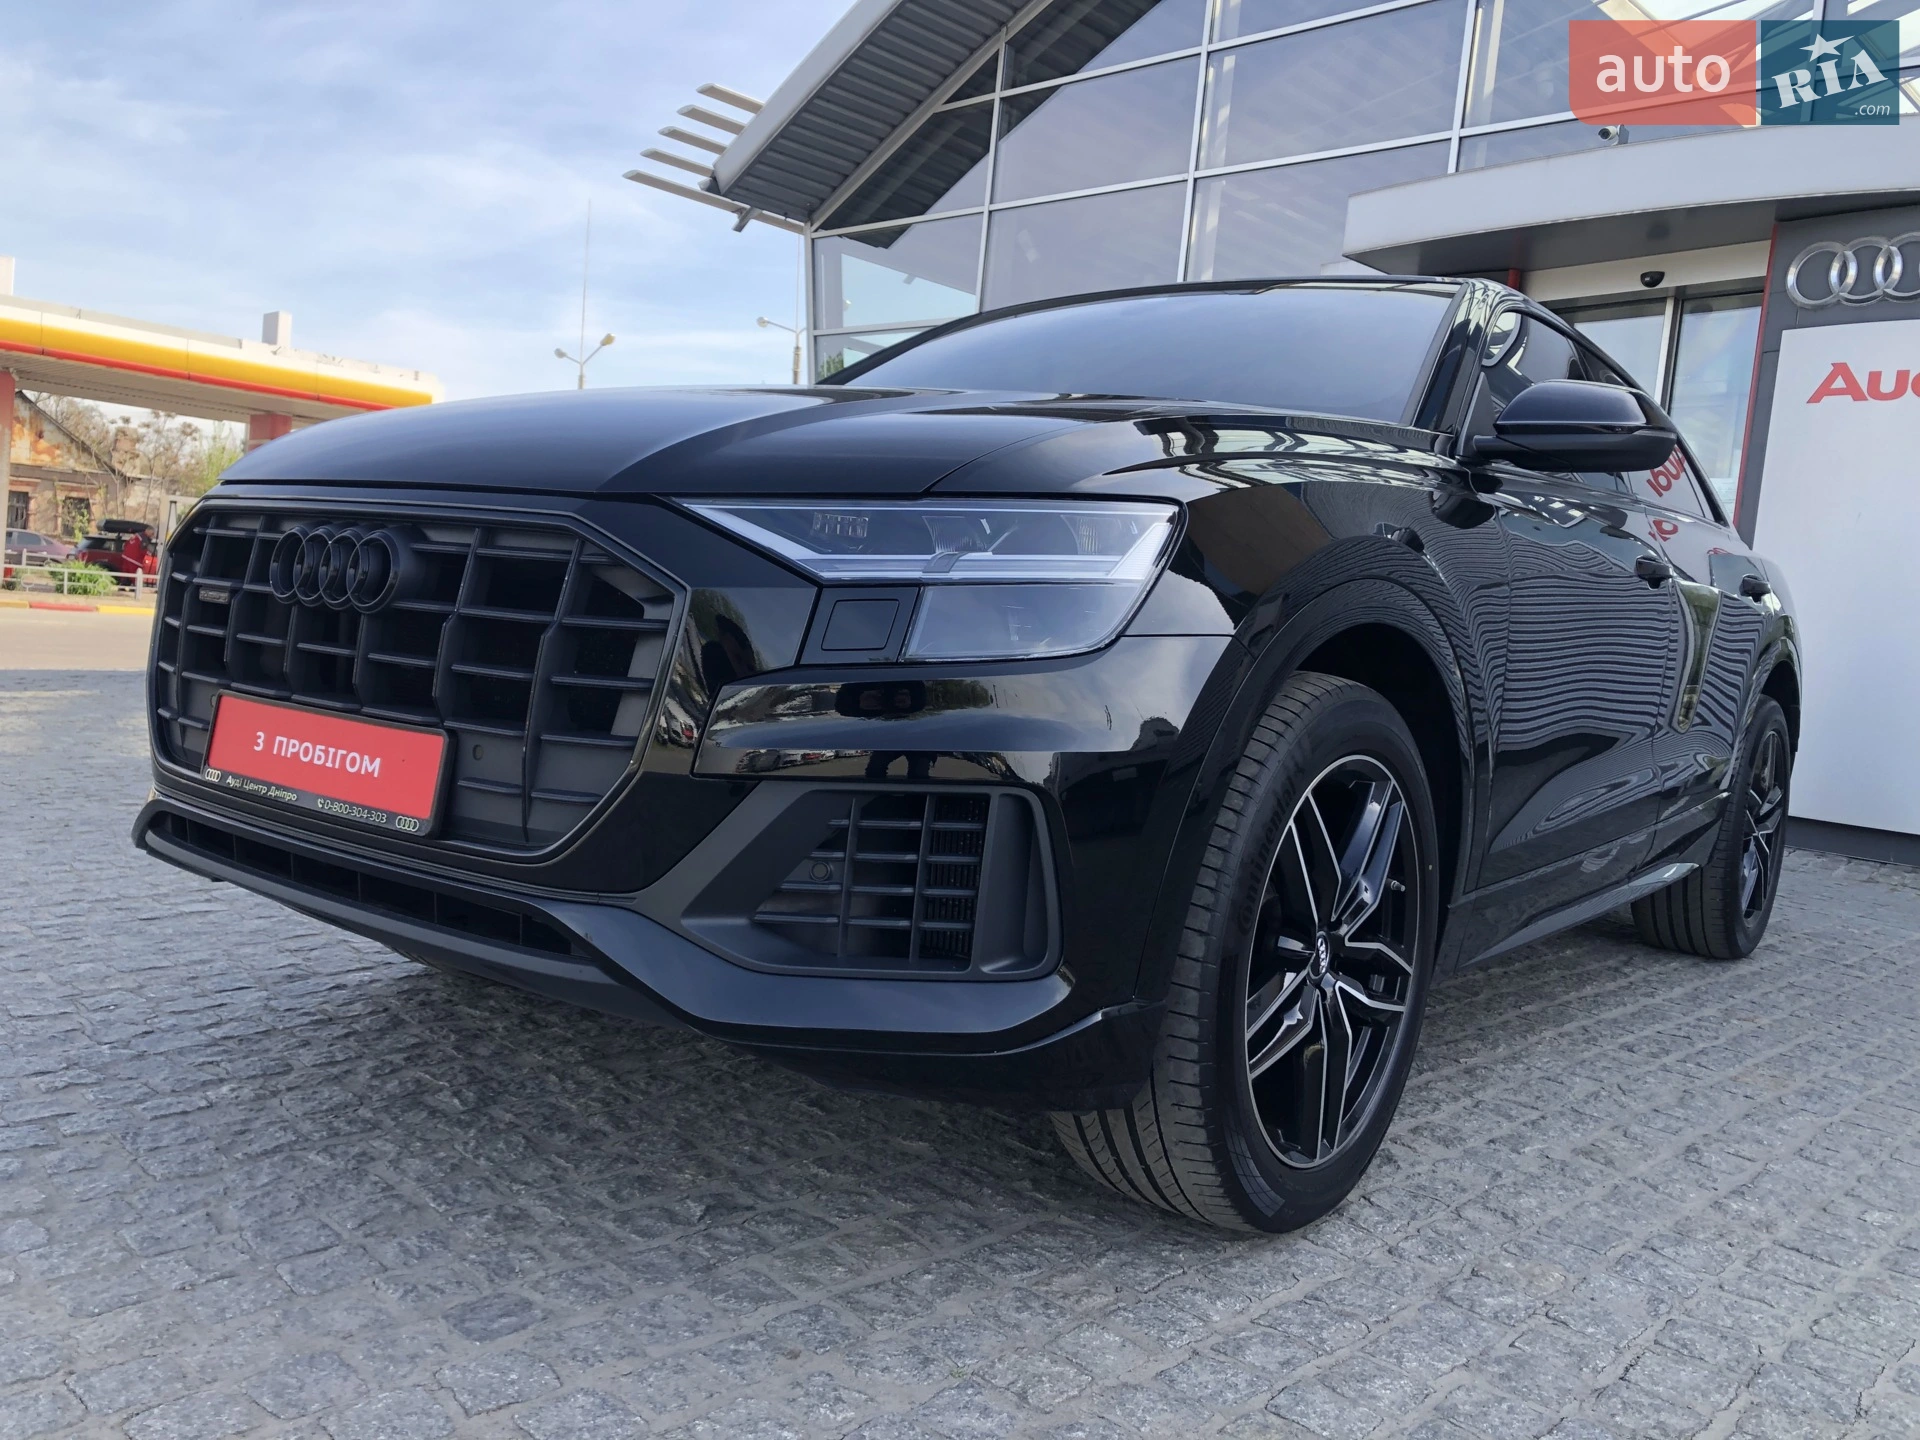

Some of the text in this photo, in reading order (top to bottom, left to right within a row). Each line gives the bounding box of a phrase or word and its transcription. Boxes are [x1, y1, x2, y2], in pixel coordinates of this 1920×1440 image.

[1806, 362, 1920, 404] Au
[254, 731, 381, 778] З ПРОБІГОМ
[226, 775, 298, 801] Ауді Центр Дніпро
[324, 800, 387, 823] 0-800-304-303
